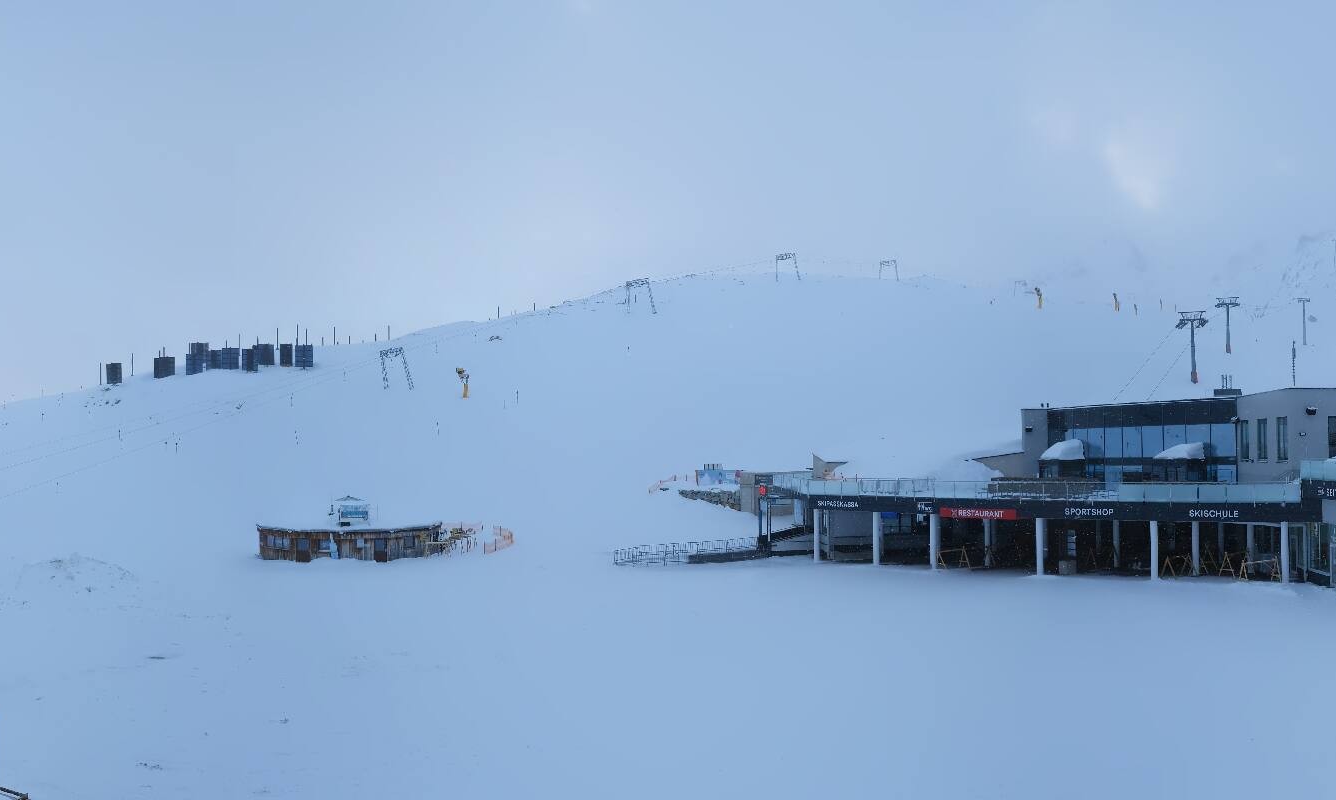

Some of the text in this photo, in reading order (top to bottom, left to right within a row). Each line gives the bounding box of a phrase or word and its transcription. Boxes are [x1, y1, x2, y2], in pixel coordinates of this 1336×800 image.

[958, 509, 1004, 518] RESTAURANT
[1064, 507, 1114, 516] SPORTSHOP
[1189, 509, 1239, 518] SKISCHULE
